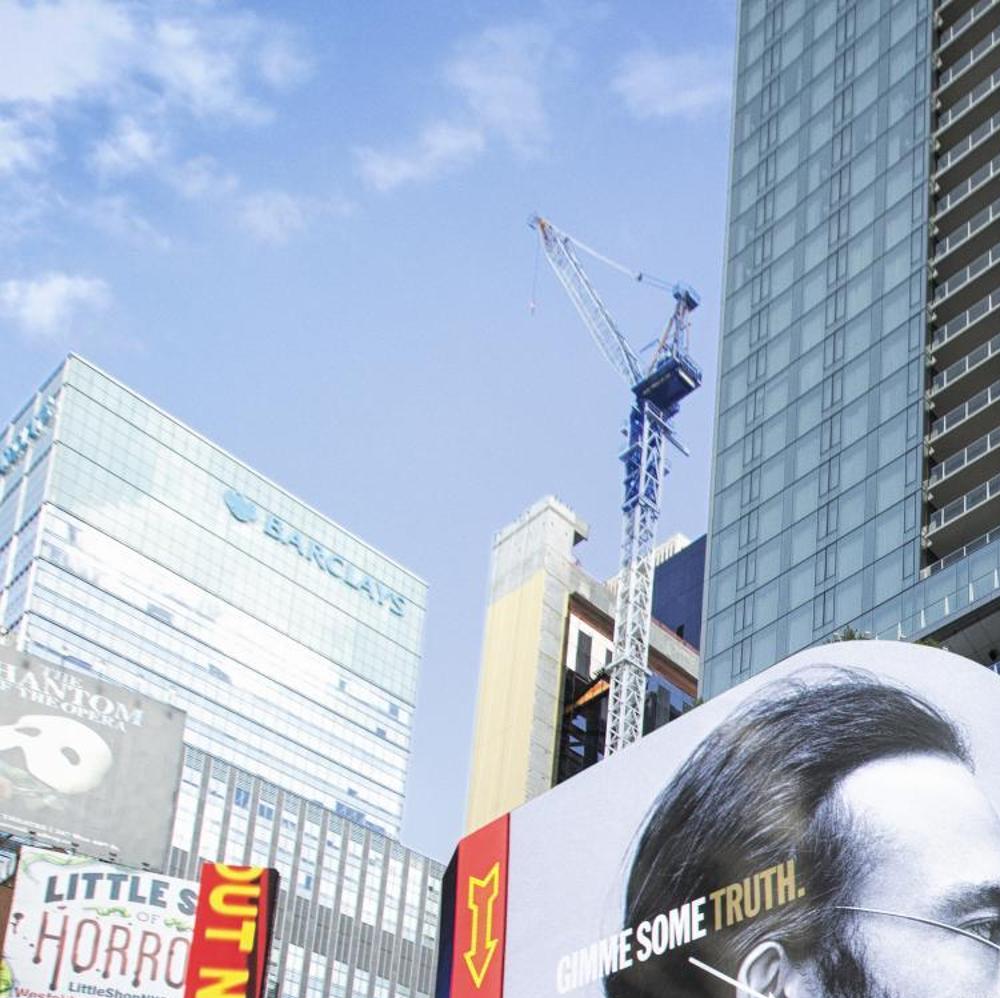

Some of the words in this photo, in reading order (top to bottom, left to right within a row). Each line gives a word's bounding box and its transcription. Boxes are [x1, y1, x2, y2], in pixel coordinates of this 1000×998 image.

[263, 514, 408, 618] BARCLAYS
[0, 663, 143, 728] HANTOM
[44, 873, 170, 908] LITTLE
[177, 888, 198, 916] S
[136, 911, 160, 925] OF
[556, 927, 634, 994] GIMME
[636, 897, 707, 962] SOME
[710, 858, 806, 931] TRUTH.
[32, 911, 190, 991] HORRO
